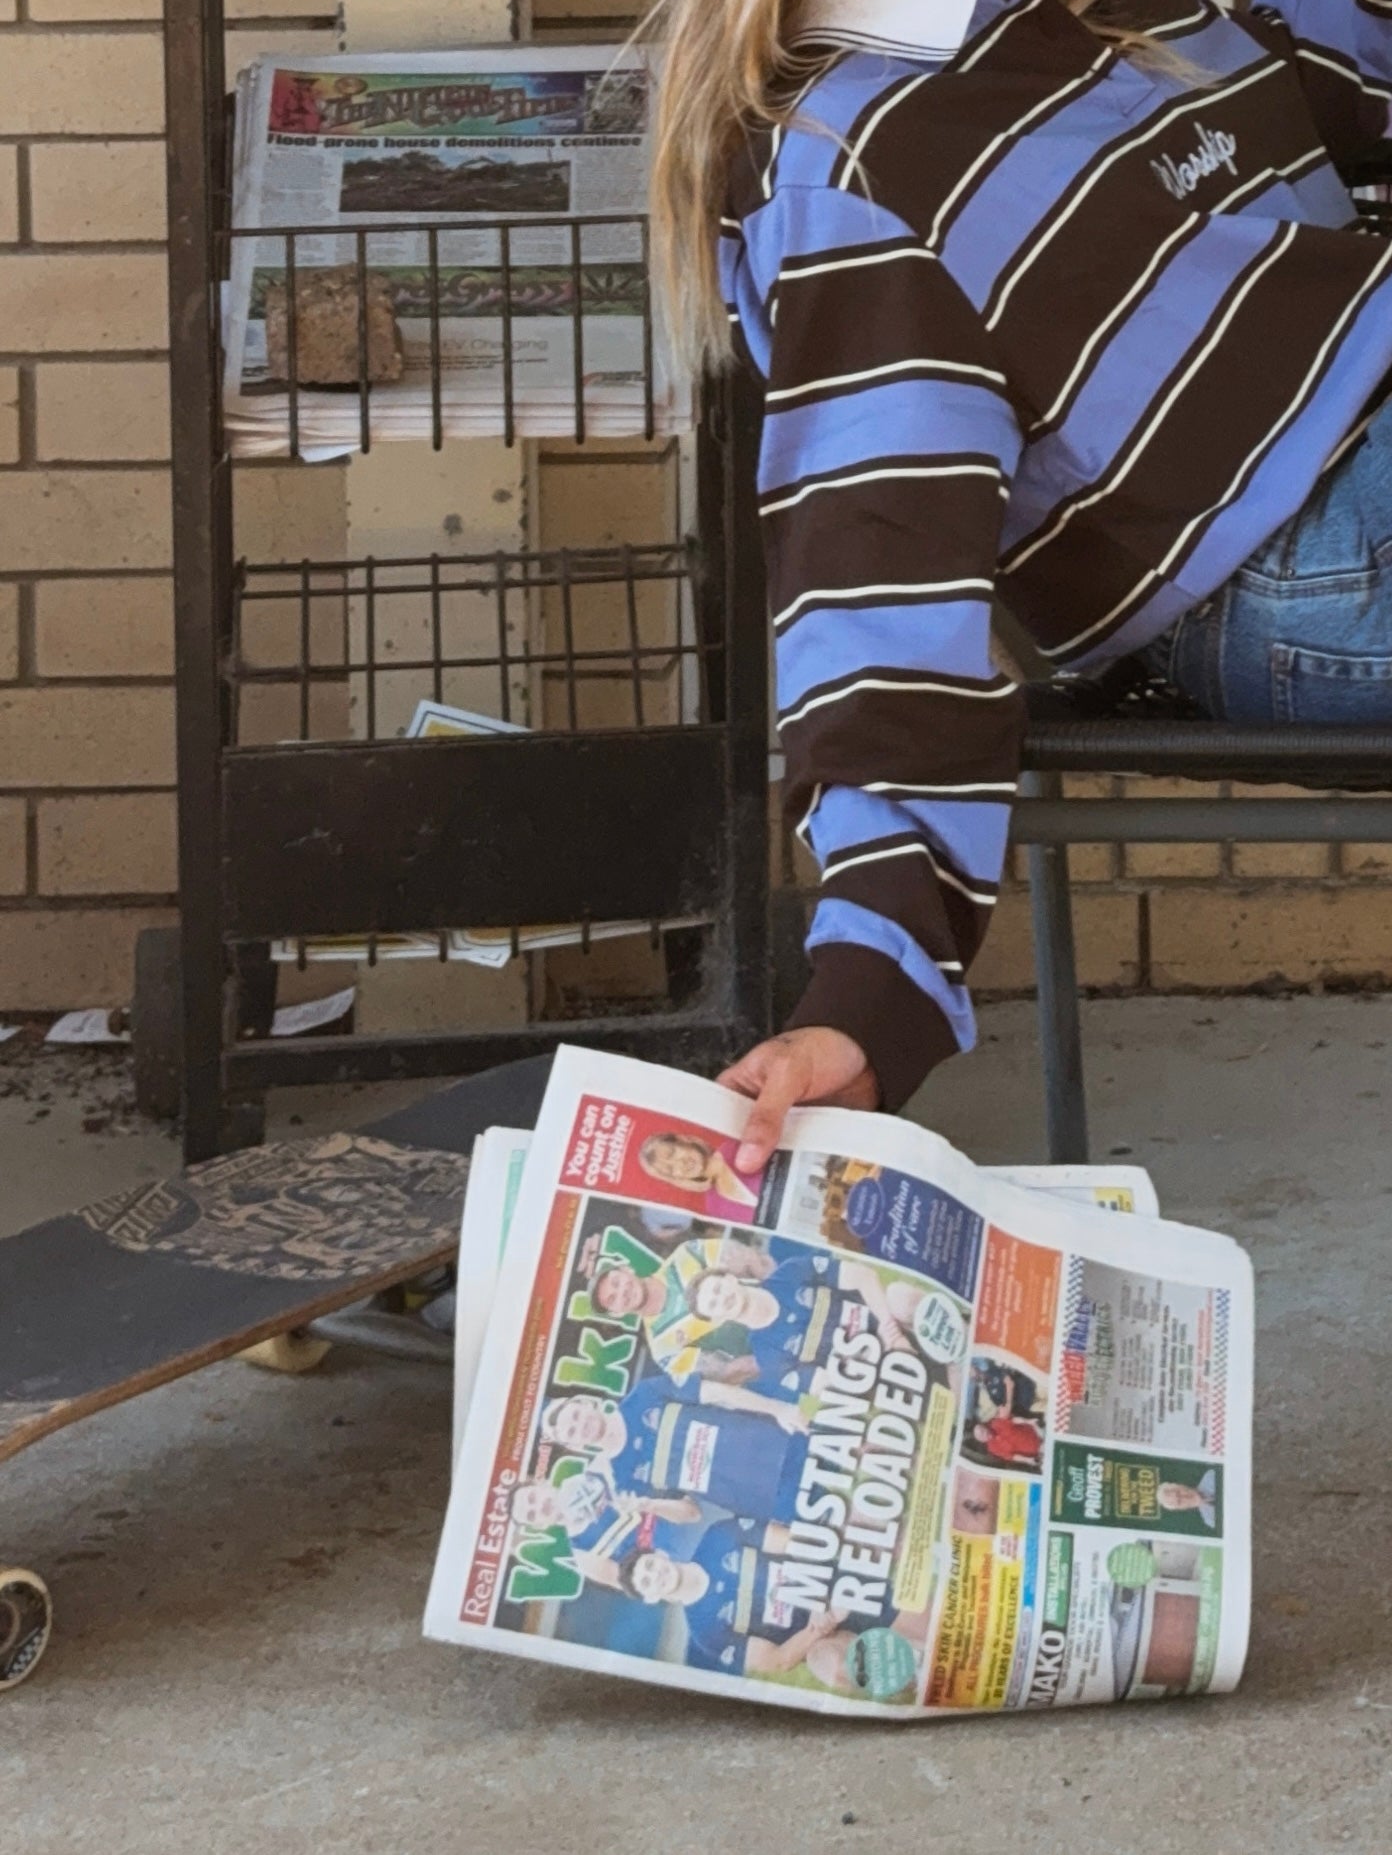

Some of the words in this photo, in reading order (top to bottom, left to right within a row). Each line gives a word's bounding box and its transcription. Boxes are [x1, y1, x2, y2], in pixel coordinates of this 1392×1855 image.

[384, 135, 440, 148] house
[445, 135, 555, 148] demolitions
[577, 1103, 600, 1138] can
[583, 1130, 610, 1186] count
[599, 1103, 617, 1129] on
[599, 1113, 631, 1182] Justine
[565, 1140, 590, 1177] You
[878, 1178, 910, 1259] Tradition
[526, 1382, 537, 1395] TO
[774, 1325, 885, 1612] MUSTANGS
[829, 1346, 931, 1617] RELOADED
[1067, 1464, 1085, 1503] Geoff
[1083, 1451, 1104, 1520] PROVEST
[1139, 1468, 1154, 1517] TWEED
[477, 1466, 519, 1554] Estate
[947, 1533, 963, 1576] CLINIC
[464, 1559, 498, 1617] Real
[941, 1576, 960, 1630] CANCER
[937, 1631, 952, 1663] SKIN
[1028, 1627, 1067, 1708] MAKO
